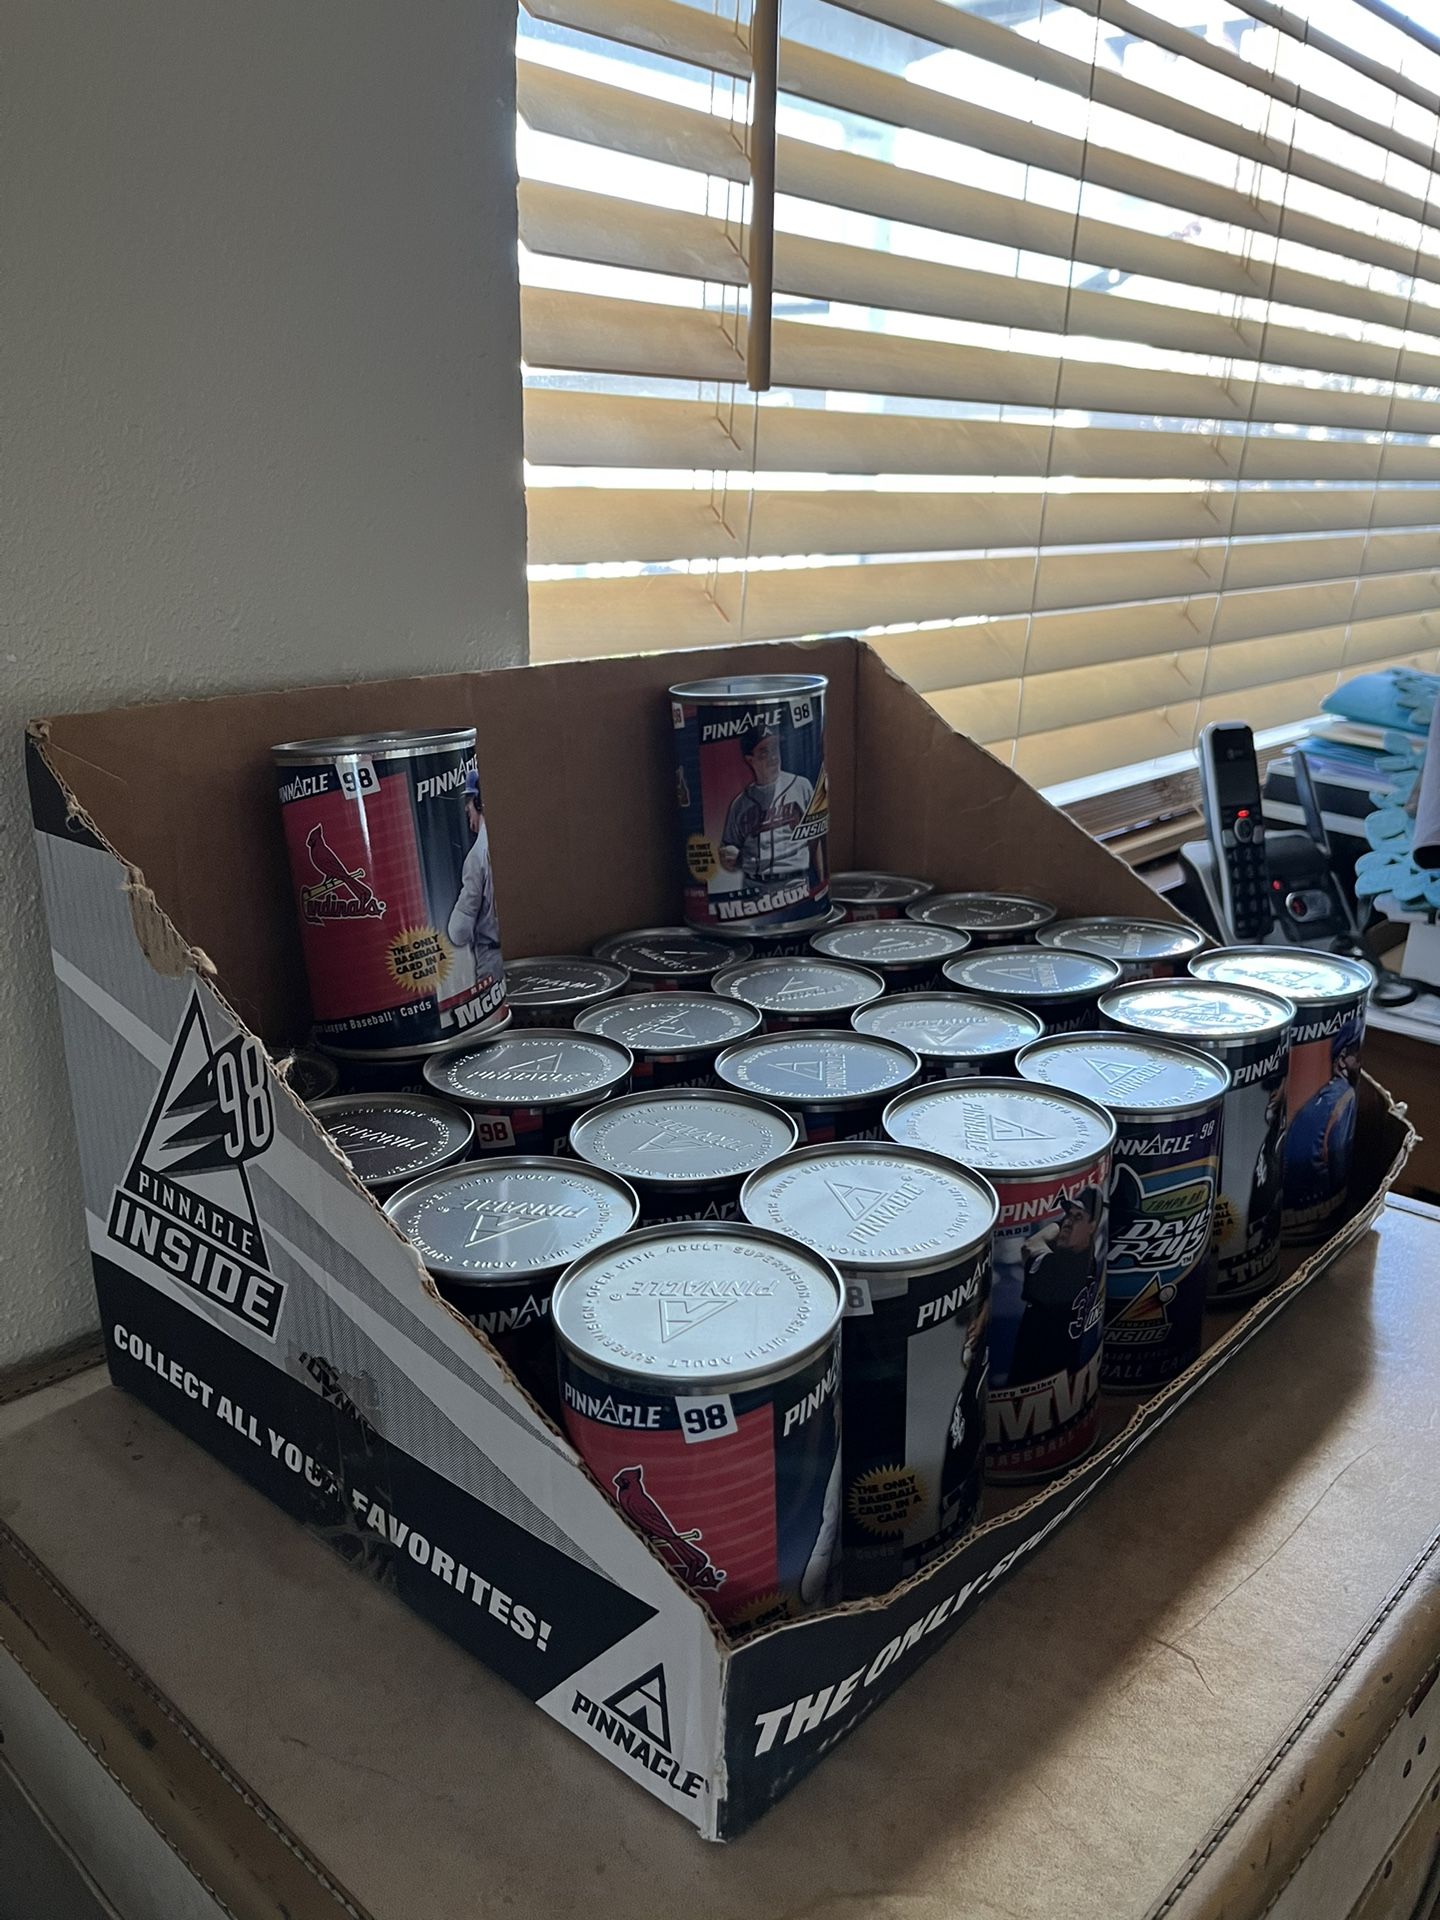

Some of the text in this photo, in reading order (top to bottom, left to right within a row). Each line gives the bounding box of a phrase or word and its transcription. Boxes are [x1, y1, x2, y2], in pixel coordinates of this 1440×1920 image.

[702, 703, 811, 741] PINNACLE 98
[280, 774, 329, 802] INNACLE
[343, 768, 373, 792] 98
[718, 884, 810, 919] Maddux
[391, 935, 438, 956] THE ONLY
[394, 945, 442, 965] BASEBALL
[396, 952, 446, 975] CARD IN A
[412, 966, 437, 980] CAN!
[349, 1012, 391, 1030] Baseball
[400, 1000, 432, 1017] Cards
[1232, 1042, 1289, 1088] PINNA
[480, 1122, 508, 1142] 98
[1113, 1134, 1193, 1157] NNACLE
[138, 1170, 254, 1254] PINNACLE
[847, 1180, 926, 1245] PINNACLE
[999, 1170, 1099, 1223] PINNACLE
[1117, 1203, 1213, 1239] DEVIL
[1106, 1223, 1207, 1264] RAYS
[114, 1198, 276, 1328] INSIDE
[916, 1252, 992, 1328] PINNA
[1105, 1328, 1166, 1342] NSIDE
[564, 1367, 840, 1437] PINNACLE 98 PINN
[988, 1378, 1058, 1400] arry Walker
[113, 1323, 213, 1409] COLLECT
[216, 1395, 262, 1447] ALL
[352, 1488, 552, 1652] FAVORITES!
[858, 1475, 915, 1494] THE ONLY
[858, 1486, 918, 1505] BASEBALL
[859, 1503, 891, 1515] CARD
[913, 1494, 922, 1504] A
[877, 1509, 907, 1523] CAN!
[754, 1664, 867, 1757] THE
[863, 1571, 988, 1688] ONLY
[571, 1689, 704, 1799] PINNACLE
